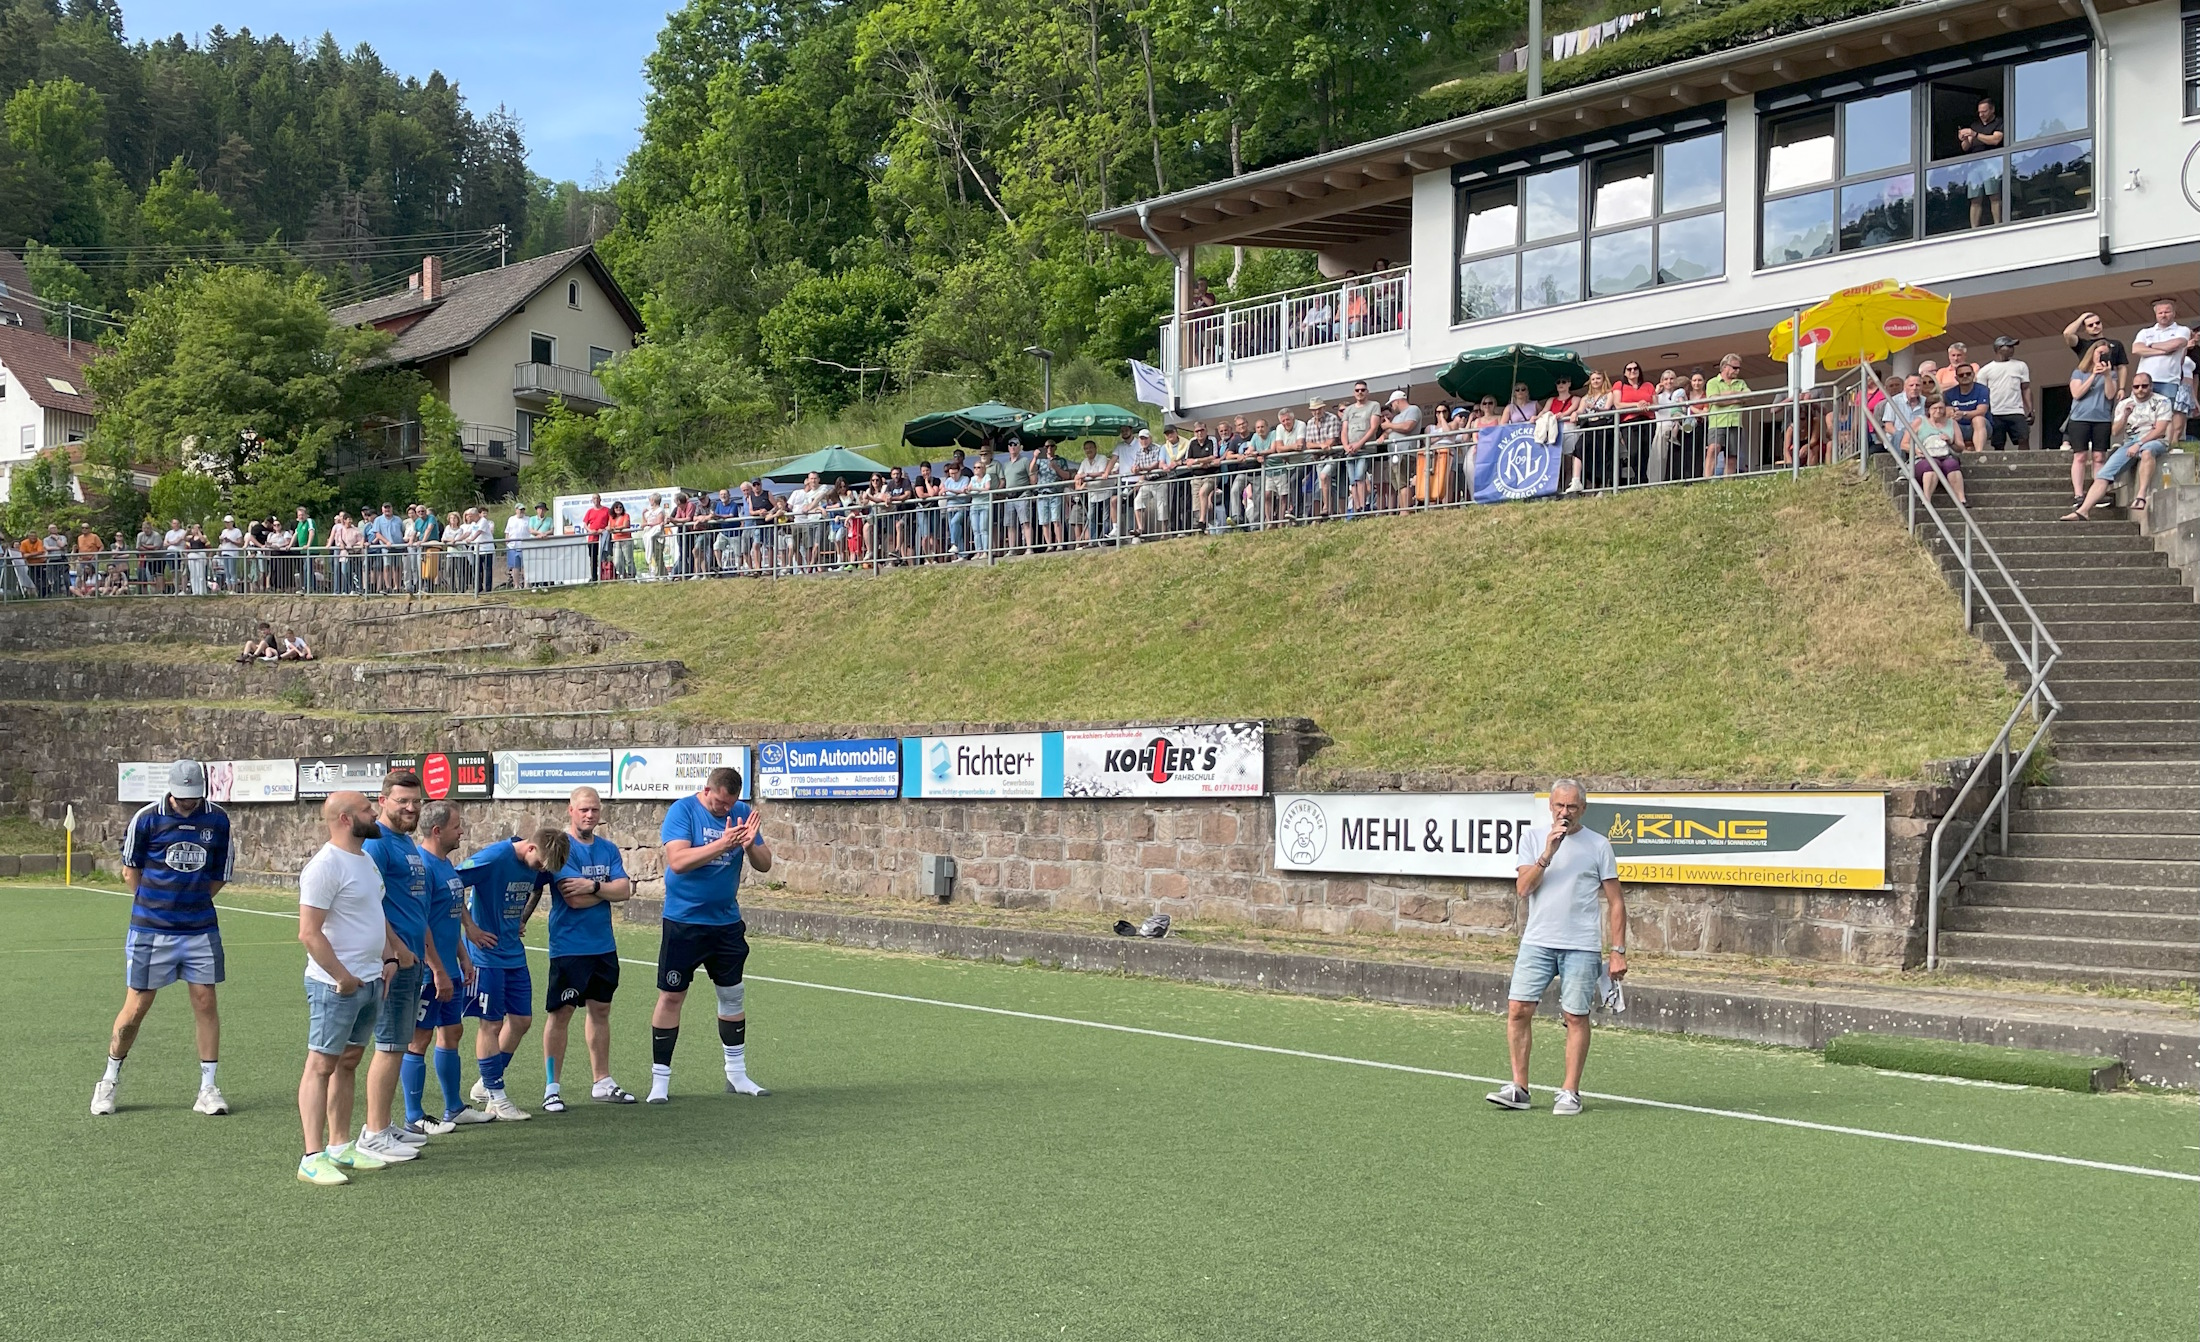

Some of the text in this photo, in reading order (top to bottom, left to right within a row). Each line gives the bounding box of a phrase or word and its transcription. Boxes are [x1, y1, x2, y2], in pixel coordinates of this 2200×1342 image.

[1510, 428, 1536, 438] KICKE
[1493, 479, 1537, 499] LAUTERBACH
[708, 752, 723, 764] ODER
[789, 746, 897, 767] Sum Automobile
[1104, 739, 1218, 783] KOHLER'S
[457, 766, 486, 784] HILS
[545, 769, 563, 777] STORZ
[762, 766, 784, 774] SUBARU
[806, 775, 840, 783] Oberwolfach
[854, 774, 887, 783] Allmendstr.
[888, 775, 896, 783] 15
[1002, 779, 1035, 787] Gewerbebau
[1174, 773, 1215, 782] FAHRSCHULE
[624, 783, 670, 792] MAURER
[761, 788, 790, 797] HYUNDAI
[1201, 784, 1213, 792] TEL.
[1342, 817, 1416, 852] MEHL
[1423, 818, 1444, 853] &
[1637, 820, 1768, 839] KING
[1617, 865, 1638, 879] 22)
[1642, 866, 1674, 879] 4314
[1685, 868, 1848, 887] www.schreinerking.de
[478, 991, 489, 1015] 4
